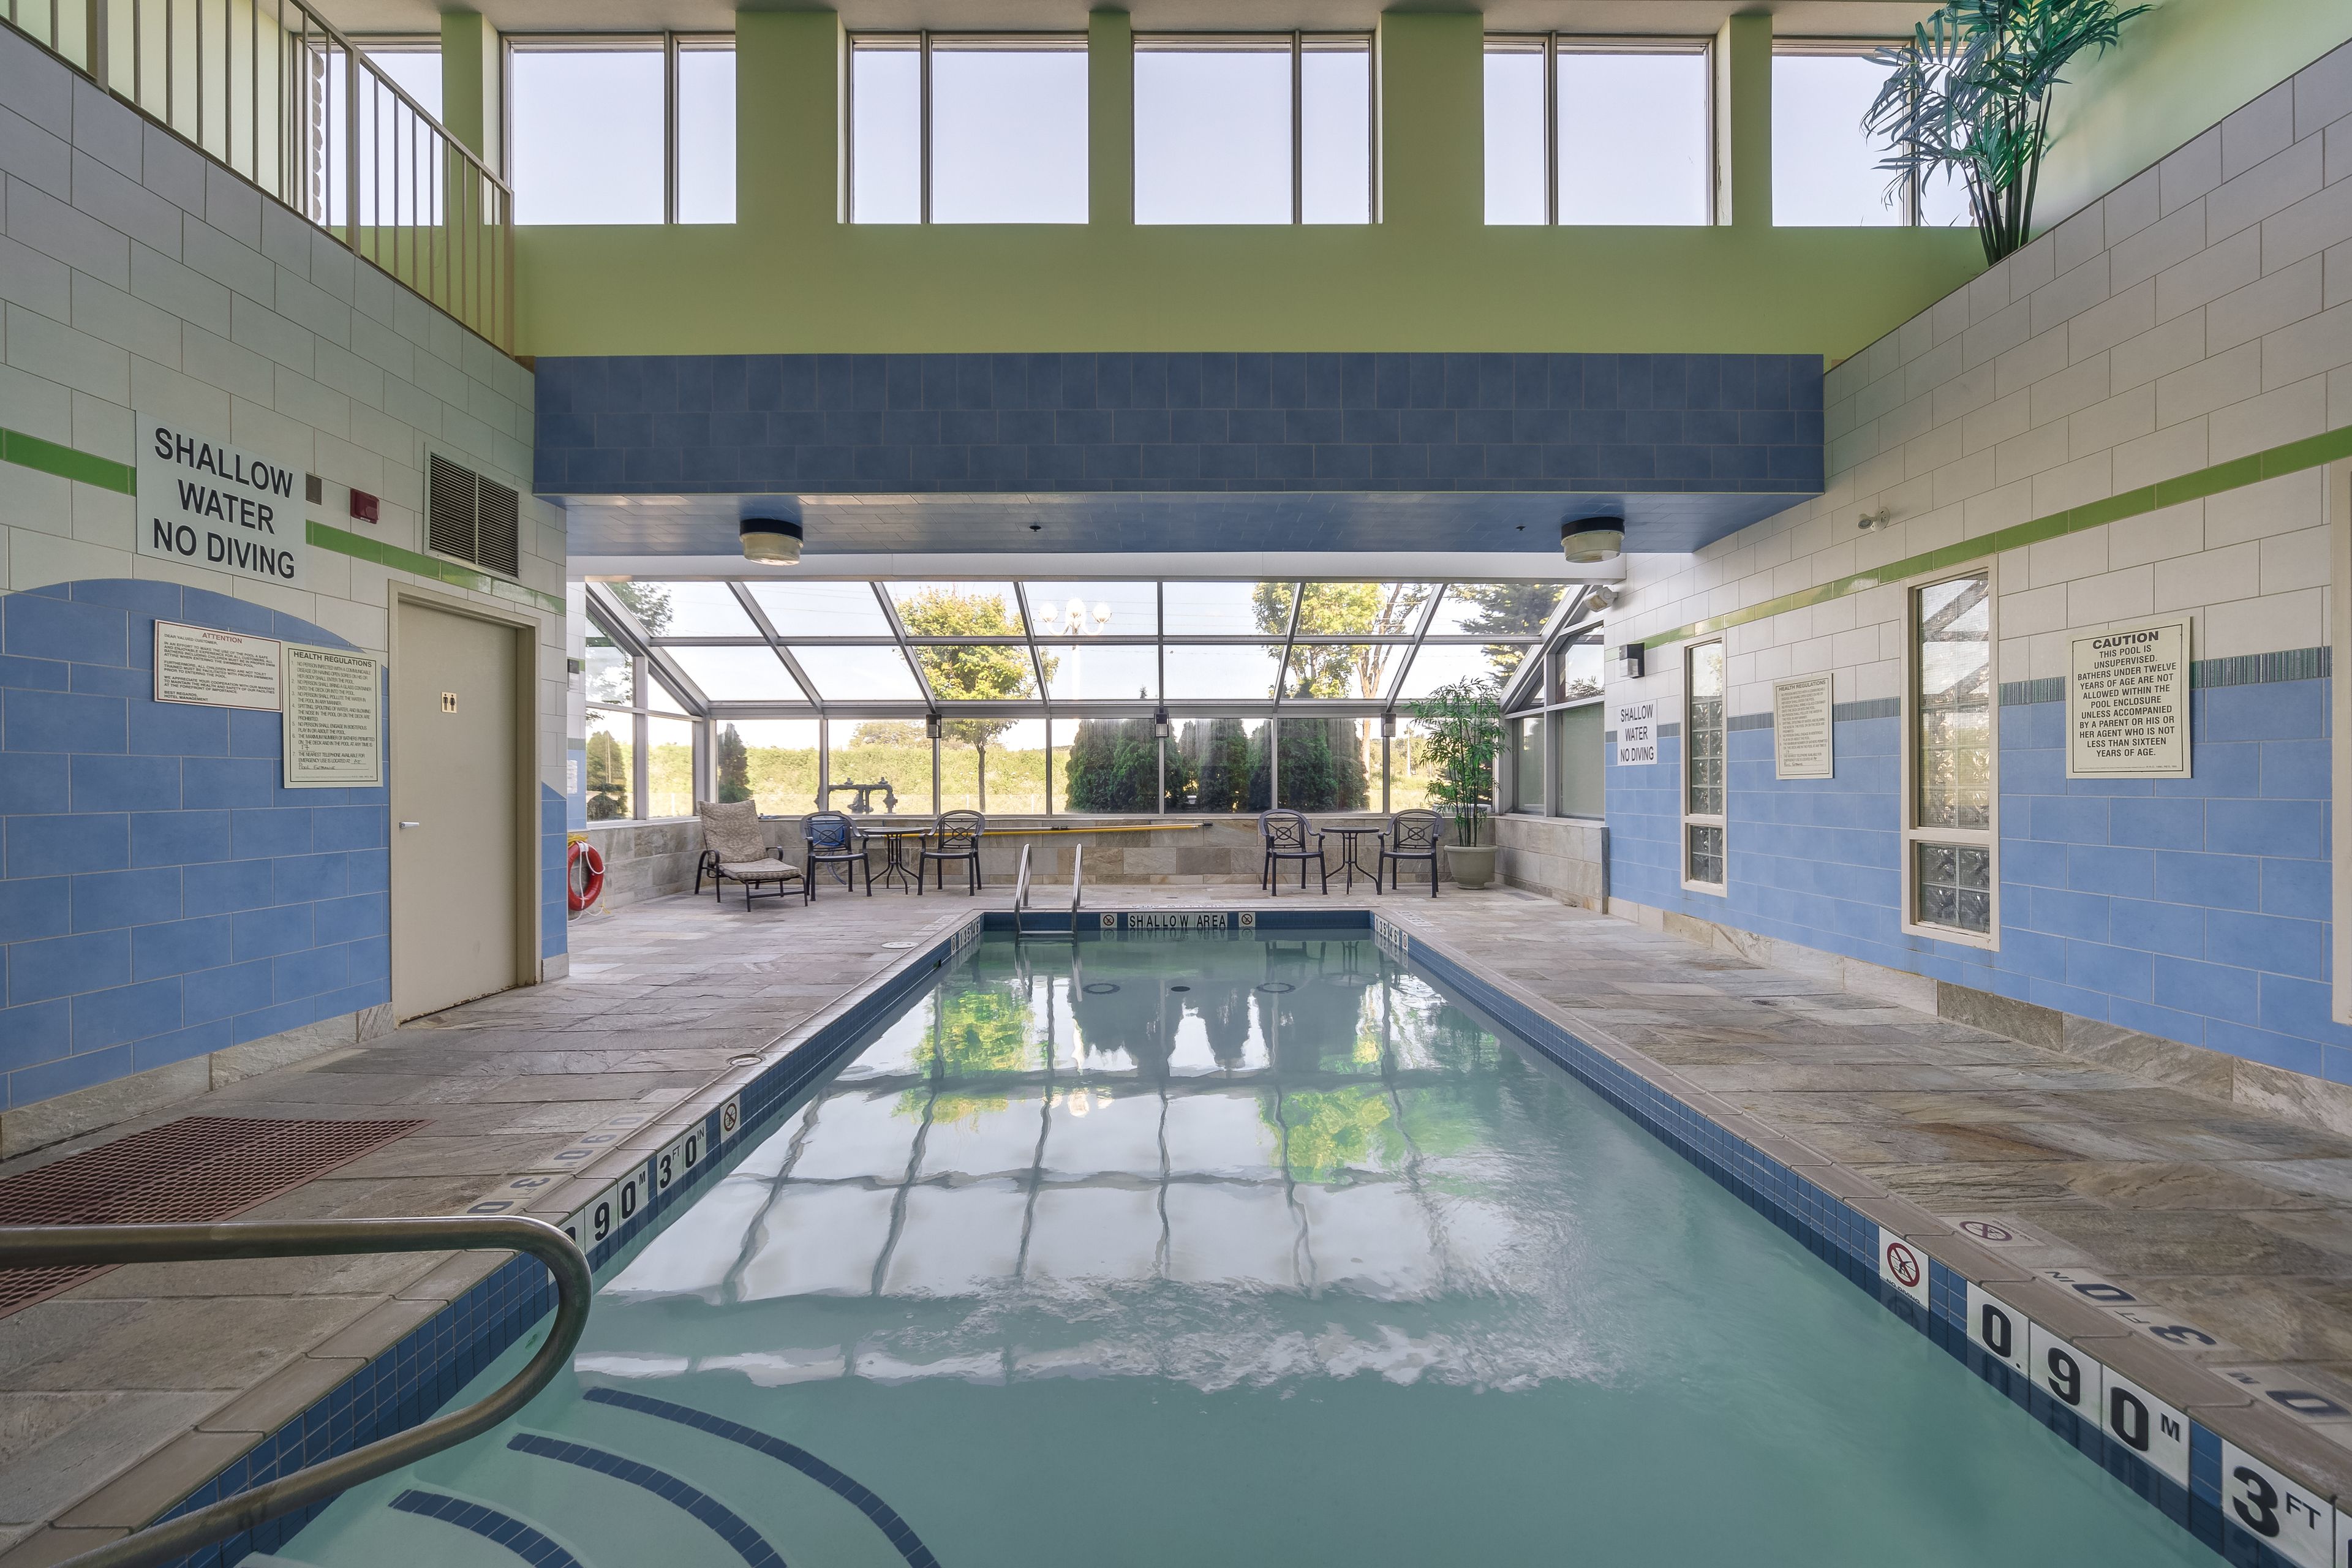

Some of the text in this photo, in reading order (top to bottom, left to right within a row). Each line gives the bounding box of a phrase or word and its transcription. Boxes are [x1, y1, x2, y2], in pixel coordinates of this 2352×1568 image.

[155, 428, 293, 499] SHALLOW
[178, 479, 275, 534] WATER
[154, 518, 294, 579] NO DIVING
[202, 632, 241, 643] ATTENTION
[2092, 630, 2158, 649] CAUTION
[293, 650, 371, 667] HEALTH REGULATIONS
[2099, 649, 2116, 658] THIS
[2119, 646, 2140, 655] POOL
[2094, 654, 2157, 669] UNSUPERVISED.
[2078, 662, 2176, 680] BATHERS UNDER TWELVE
[1796, 680, 1825, 689] REGULATIONS
[2080, 680, 2103, 690] YEARS
[2138, 675, 2154, 684] ARE
[2157, 673, 2173, 682] NOT
[2082, 684, 2169, 699] ALLOWED WITHIN THE
[2090, 695, 2161, 708] POOL ENCLOSURE
[1621, 704, 1653, 722] SHALLOW
[2081, 705, 2172, 718] UNLESS ACCOMPANIED
[2099, 718, 2128, 727] PARENT
[2158, 726, 2174, 734] NOT
[1626, 726, 1648, 741] WATER
[2132, 737, 2166, 745] SIXTEEN
[1621, 746, 1654, 762] NO DIVING
[1129, 915, 1225, 927] SHALLOW AREA
[1886, 1278, 1921, 1304] NO DIVING
[2161, 1412, 2180, 1443] M
[2233, 1466, 2321, 1537] 3 FT
